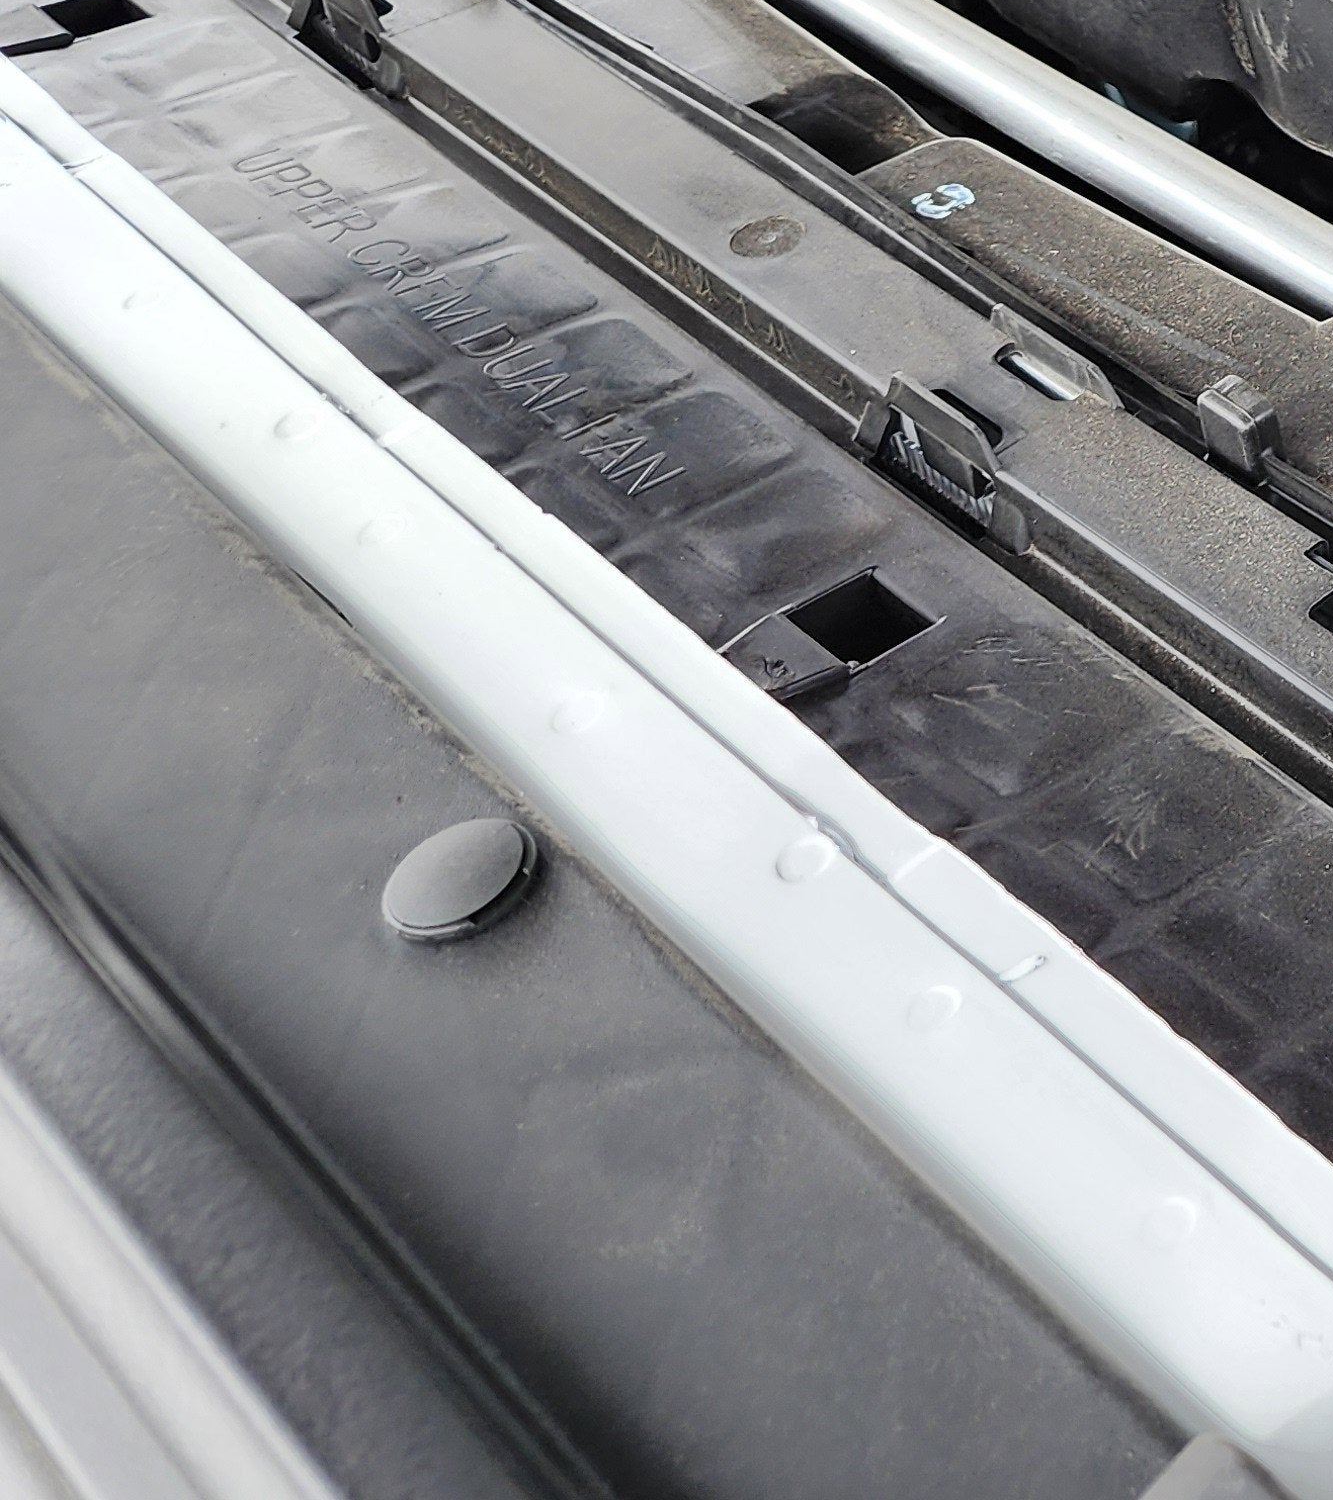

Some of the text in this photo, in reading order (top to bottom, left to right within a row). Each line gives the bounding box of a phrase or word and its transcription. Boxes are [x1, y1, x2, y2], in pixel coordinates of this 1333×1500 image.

[232, 147, 377, 243] UPPER
[450, 322, 588, 426] DUAL
[560, 412, 687, 496] FAN
